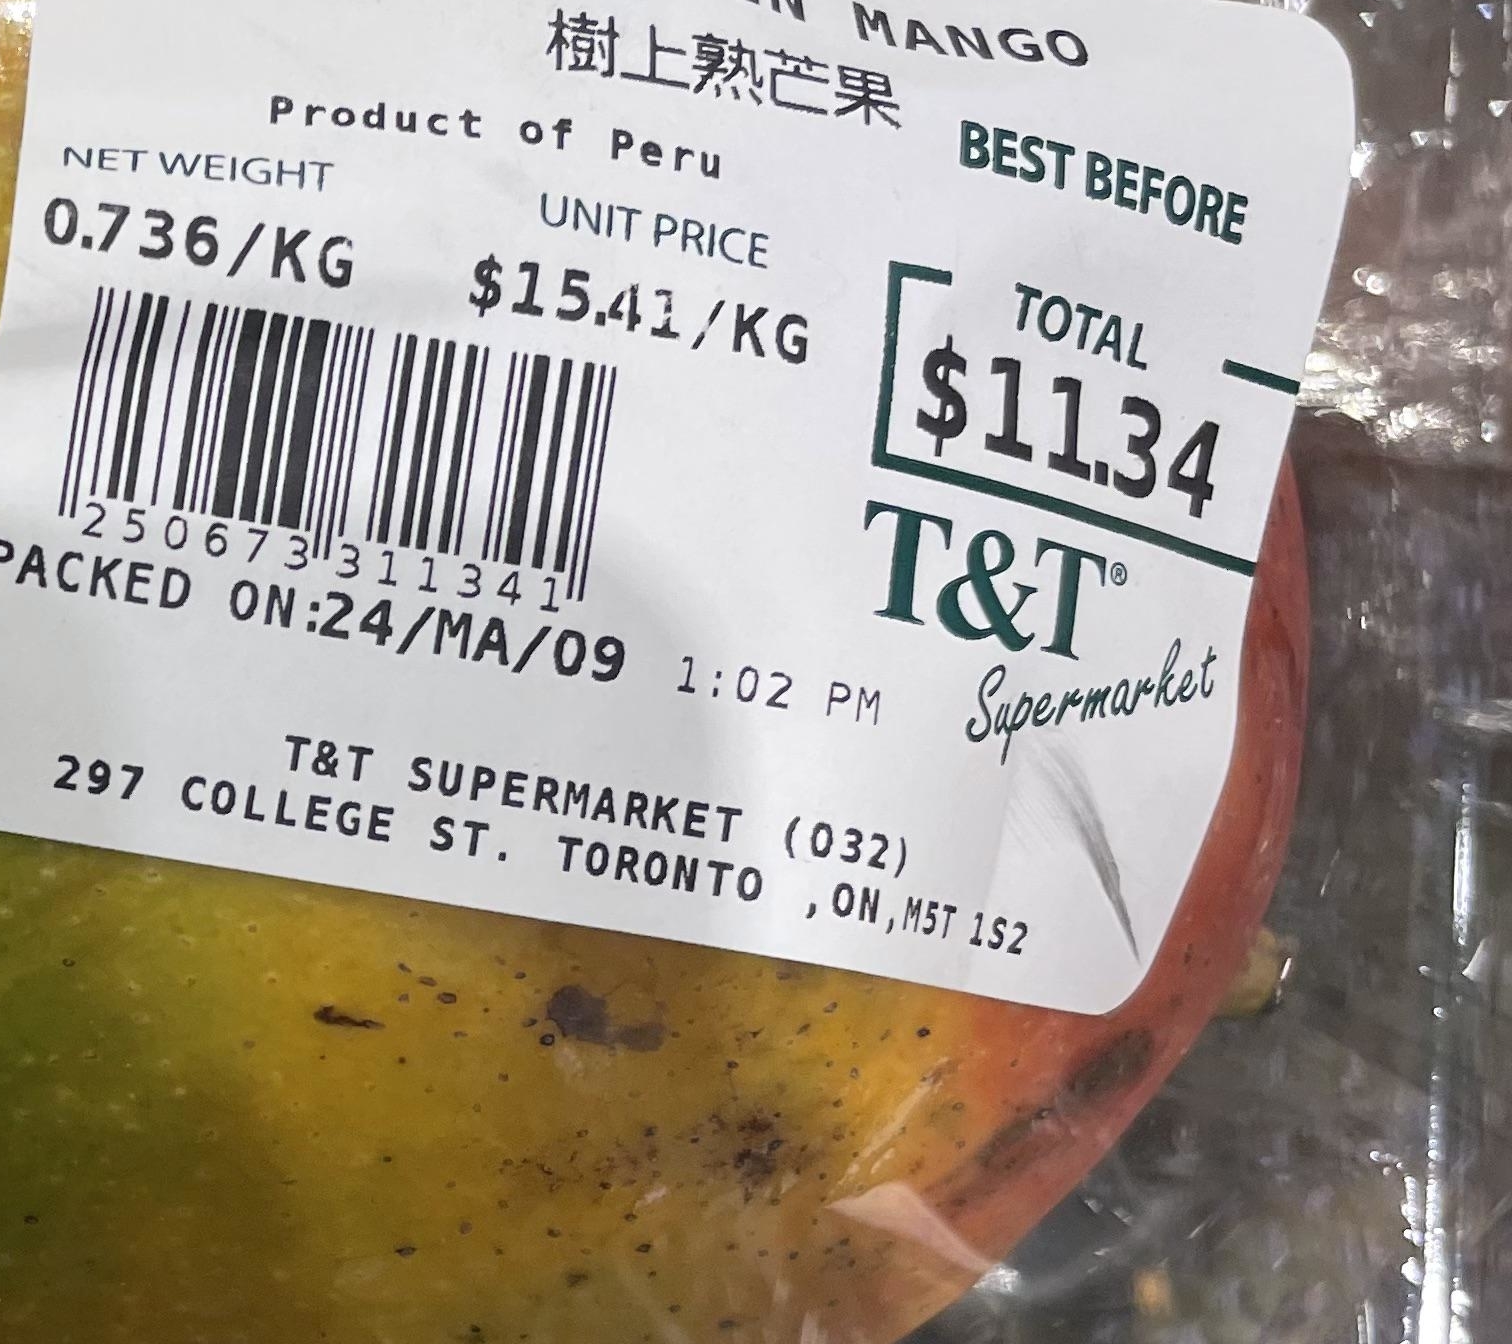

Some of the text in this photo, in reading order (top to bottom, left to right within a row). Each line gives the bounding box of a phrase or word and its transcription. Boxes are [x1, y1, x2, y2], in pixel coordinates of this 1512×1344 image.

[547, 7, 901, 129] 樹上熟芒果
[852, 0, 1089, 68] MANGO
[63, 145, 336, 192] NET WEIGHT
[269, 95, 722, 179] Product of Peru
[959, 120, 1248, 246] BEST BEFORE
[44, 196, 355, 289] 0.736/KG
[539, 193, 771, 270] UNIT PRICE
[468, 253, 810, 366] $15.41/KG
[1014, 281, 1148, 371] TOTAL
[916, 334, 1220, 519] $11.34
[677, 656, 881, 727] 1:02 PM
[965, 638, 1217, 766] Supermarket
[54, 754, 144, 801] 297
[181, 776, 395, 843] COLLEGE
[430, 816, 508, 863] ST.
[558, 835, 763, 902] TORONTO
[968, 916, 1029, 956] 1S2
[284, 735, 908, 878] T&T SUPERMARKET (032)
